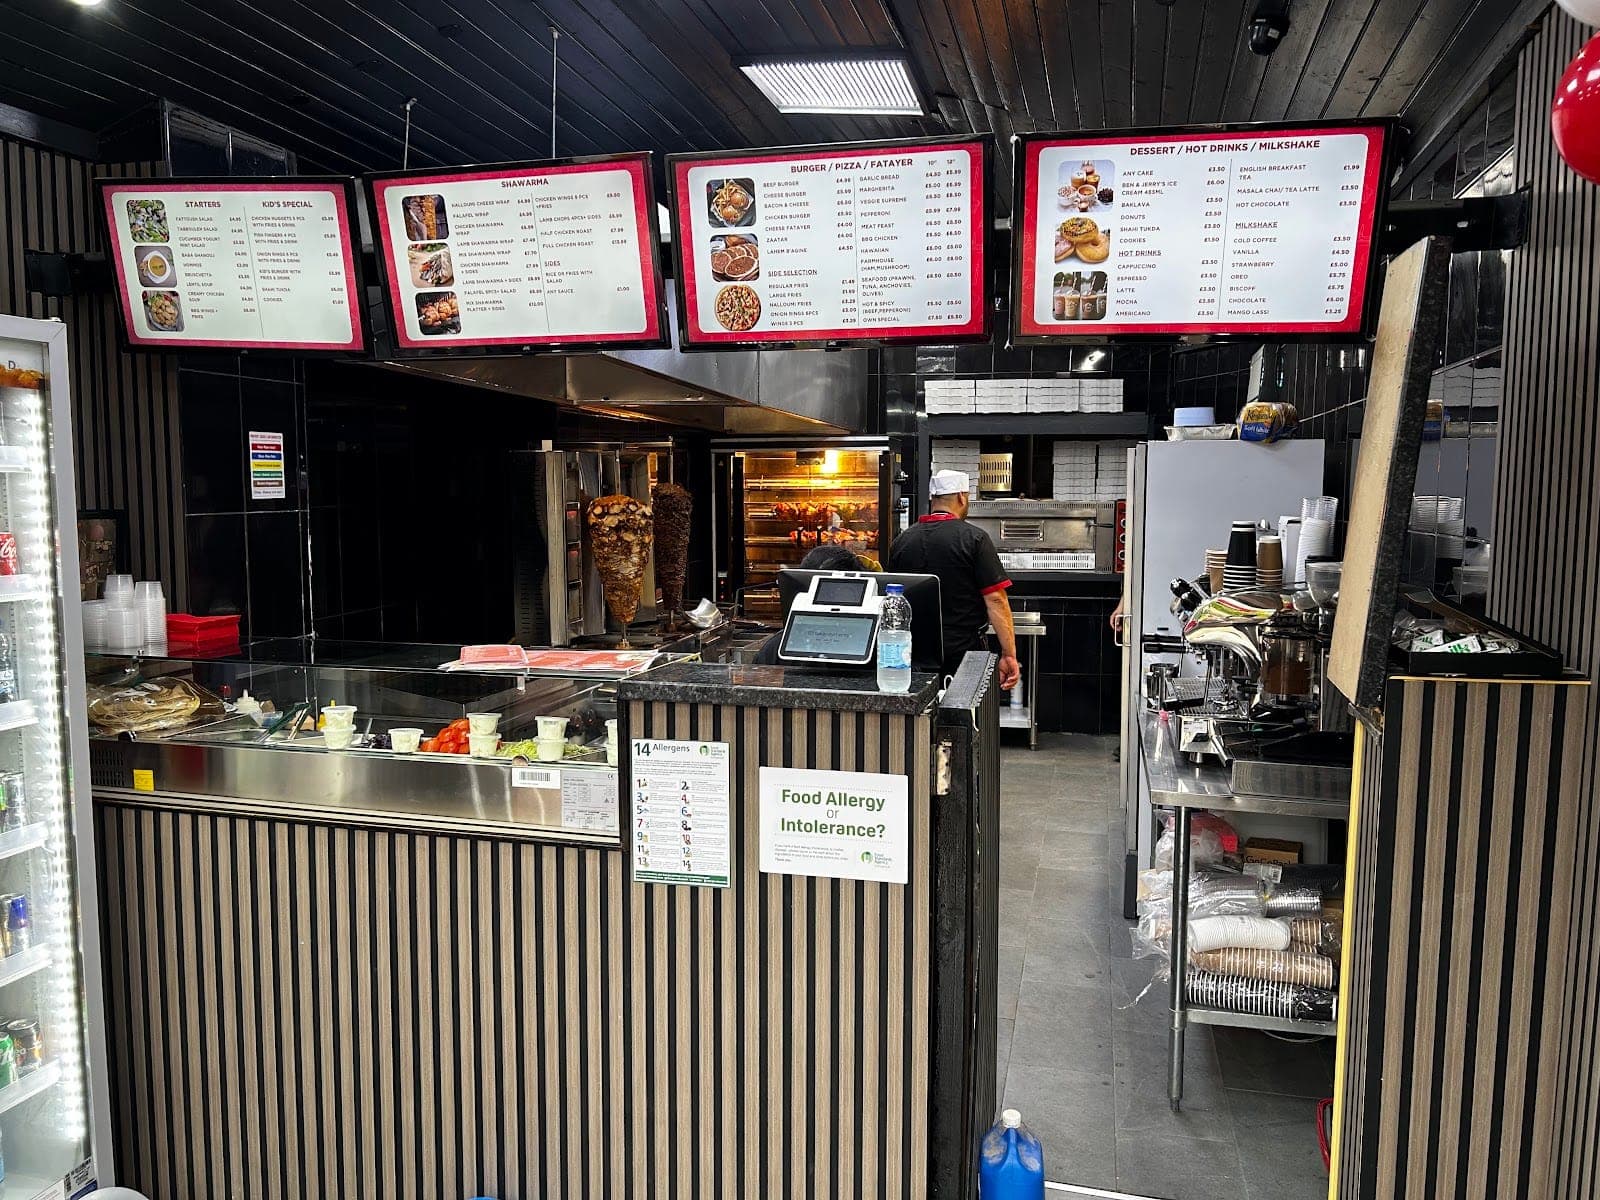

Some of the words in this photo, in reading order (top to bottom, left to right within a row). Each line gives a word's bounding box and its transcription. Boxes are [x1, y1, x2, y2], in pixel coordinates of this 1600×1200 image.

[1130, 146, 1176, 156] DESSERT
[1177, 145, 1183, 155] /
[1185, 145, 1207, 154] HOT
[1209, 143, 1248, 152] DRINKS
[1250, 142, 1257, 152] /
[1259, 140, 1321, 151] MILKSHAKE
[790, 164, 827, 173] BURGER
[828, 162, 833, 172] /
[835, 162, 862, 170] PIZZA
[863, 160, 869, 170] /
[870, 158, 913, 169] FATAYER
[1268, 164, 1307, 172] BREAKFAST
[501, 178, 549, 188] SHAWARMA
[1235, 221, 1278, 230] MILKSHAKE
[1135, 249, 1162, 257] DRINKS
[783, 269, 818, 277] SELECTION
[8, 360, 16, 370] D
[634, 742, 651, 757] 14
[652, 743, 690, 753] Allergens
[681, 781, 687, 791] 2
[637, 792, 643, 801] 3
[781, 789, 822, 805] Food
[825, 791, 886, 812] Allergy
[636, 805, 642, 815] 5
[681, 806, 688, 816] 6
[826, 809, 840, 819] or
[636, 818, 643, 828] 7
[780, 817, 886, 838] Intolerance?
[637, 831, 643, 841] 9
[682, 834, 691, 842] 10
[637, 844, 645, 853] 11
